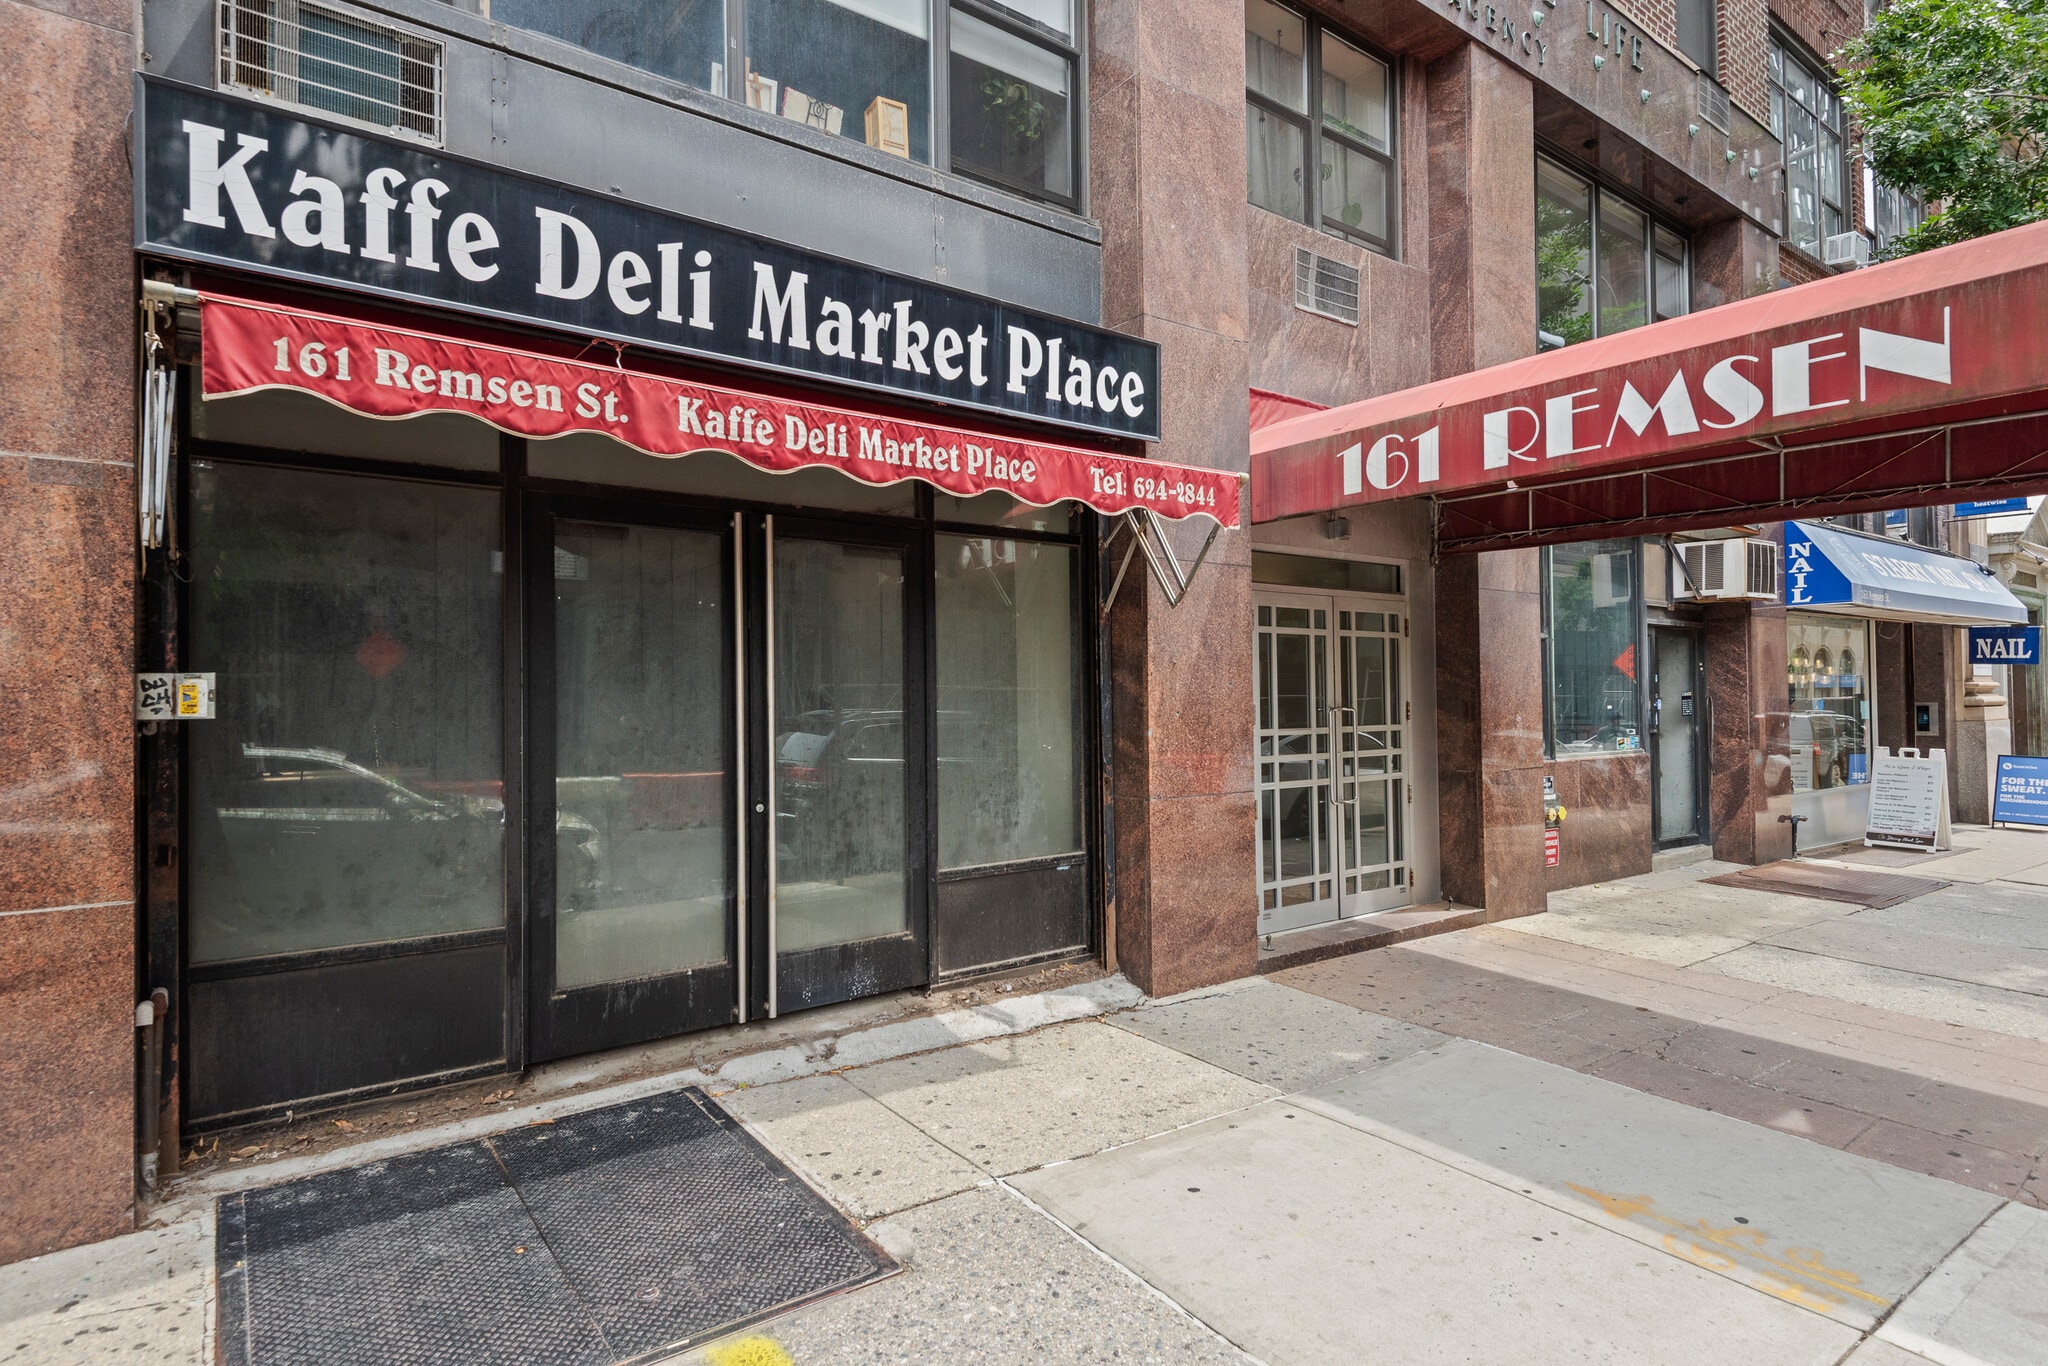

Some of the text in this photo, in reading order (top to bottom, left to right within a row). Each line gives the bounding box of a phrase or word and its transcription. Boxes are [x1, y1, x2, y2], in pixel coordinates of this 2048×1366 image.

[1587, 1, 1644, 72] LIFE
[182, 119, 1144, 418] Kaffe Deli Market Place
[273, 336, 1216, 507] 161 Remsen St. Kaffe Deli Market Place Tel: 624-2844
[1337, 306, 1952, 496] 161 REMSEN
[1788, 541, 1814, 604] NAIL
[1861, 552, 1937, 584] STARRY
[1924, 564, 1972, 590] NAIL
[1976, 638, 2032, 658] NAIL
[2001, 776, 2026, 785] FOR
[2001, 784, 2046, 795] SWEAT.
